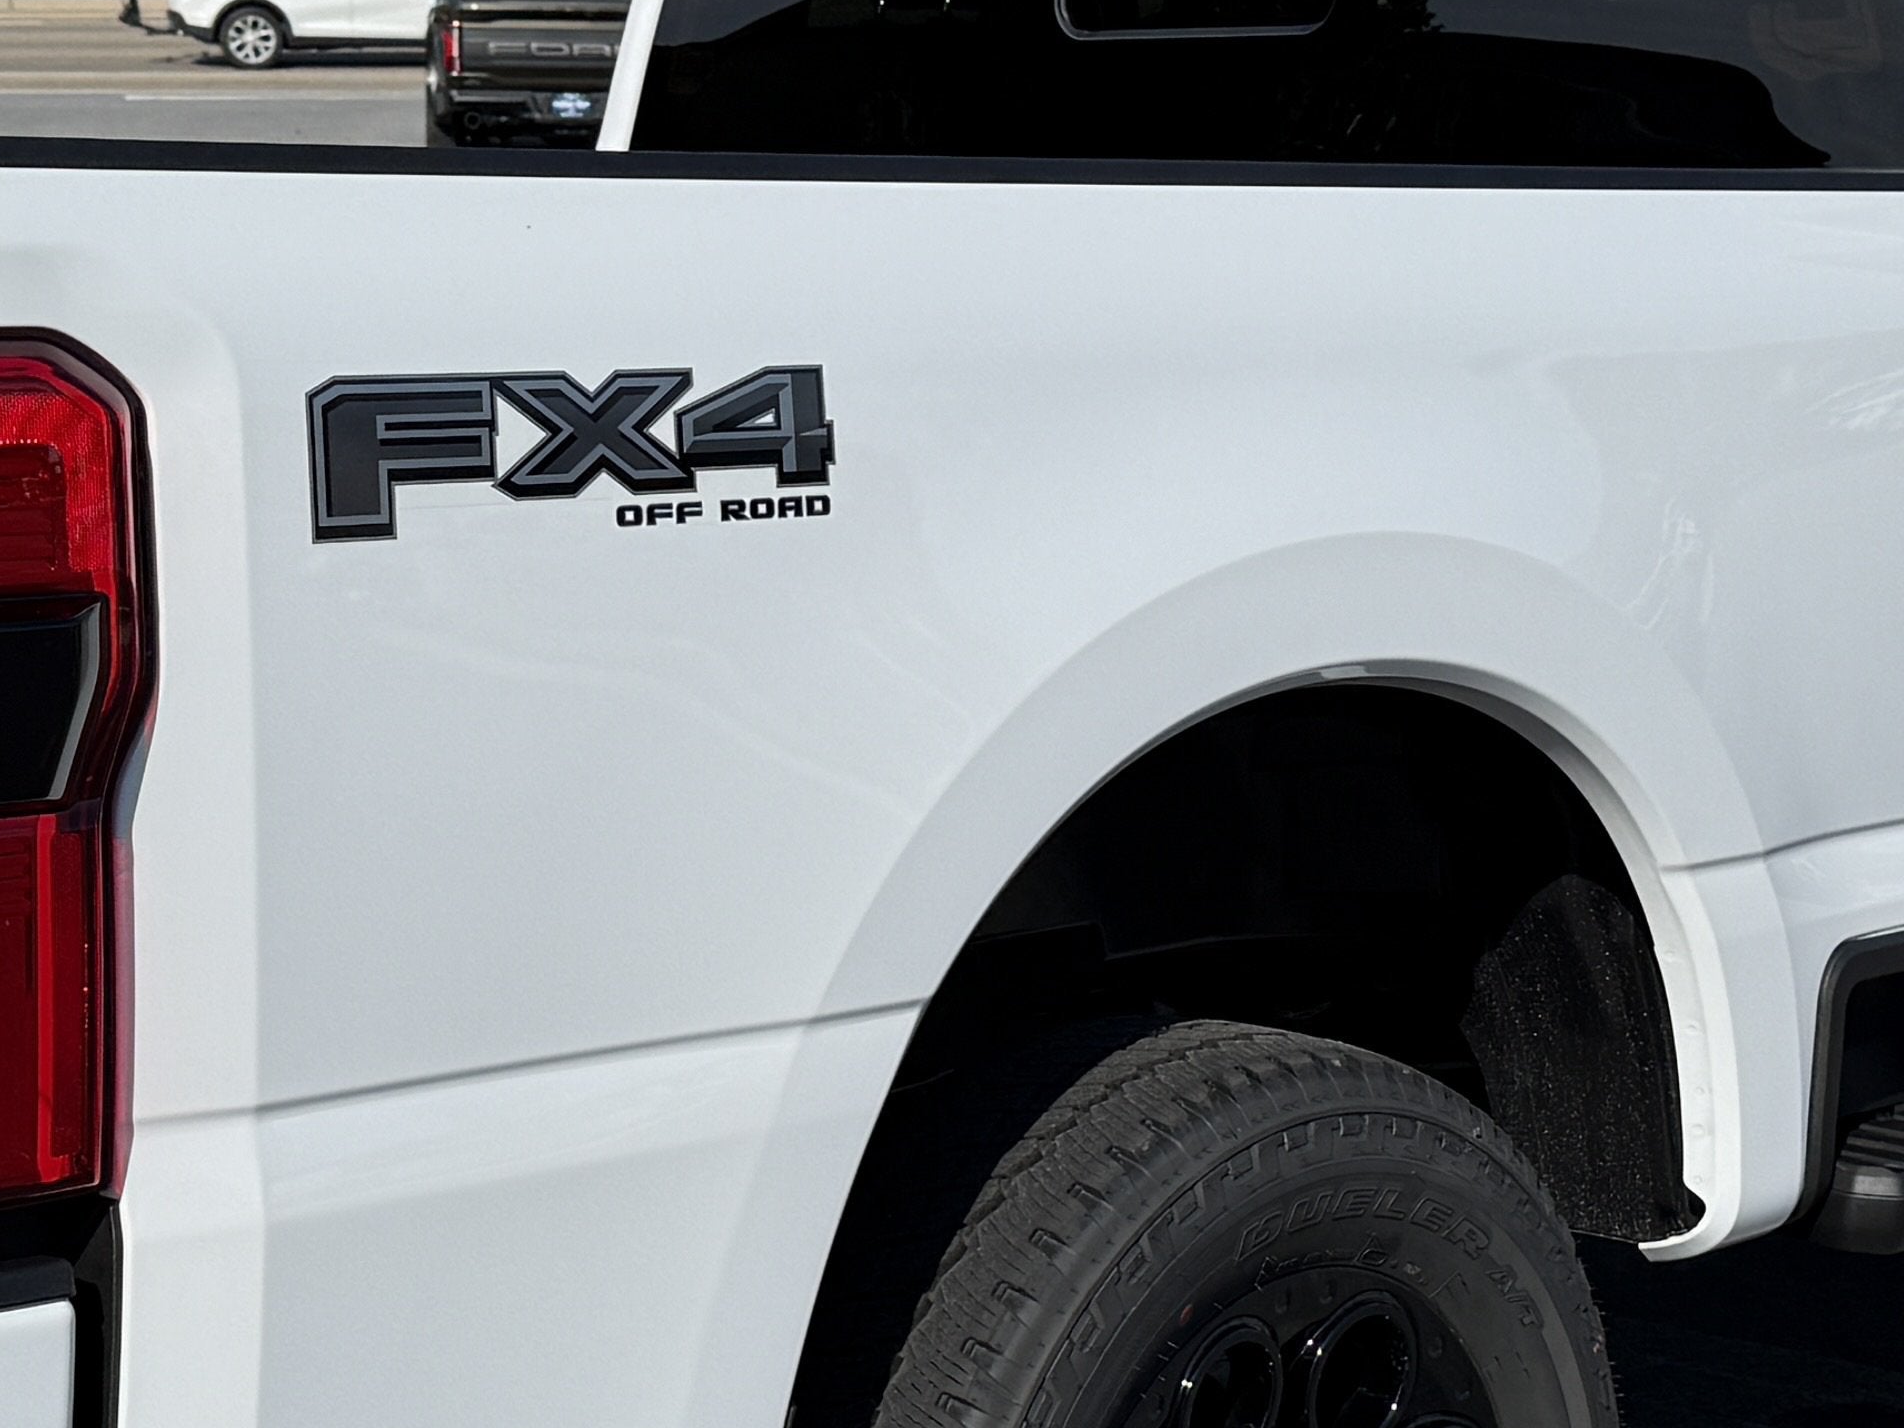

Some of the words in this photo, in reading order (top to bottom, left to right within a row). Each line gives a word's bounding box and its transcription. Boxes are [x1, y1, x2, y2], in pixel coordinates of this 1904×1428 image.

[489, 42, 620, 58] FOR
[305, 365, 835, 544] FX4
[615, 500, 704, 527] OFF
[719, 494, 832, 522] ROAD
[1235, 1186, 1491, 1261] DUELER
